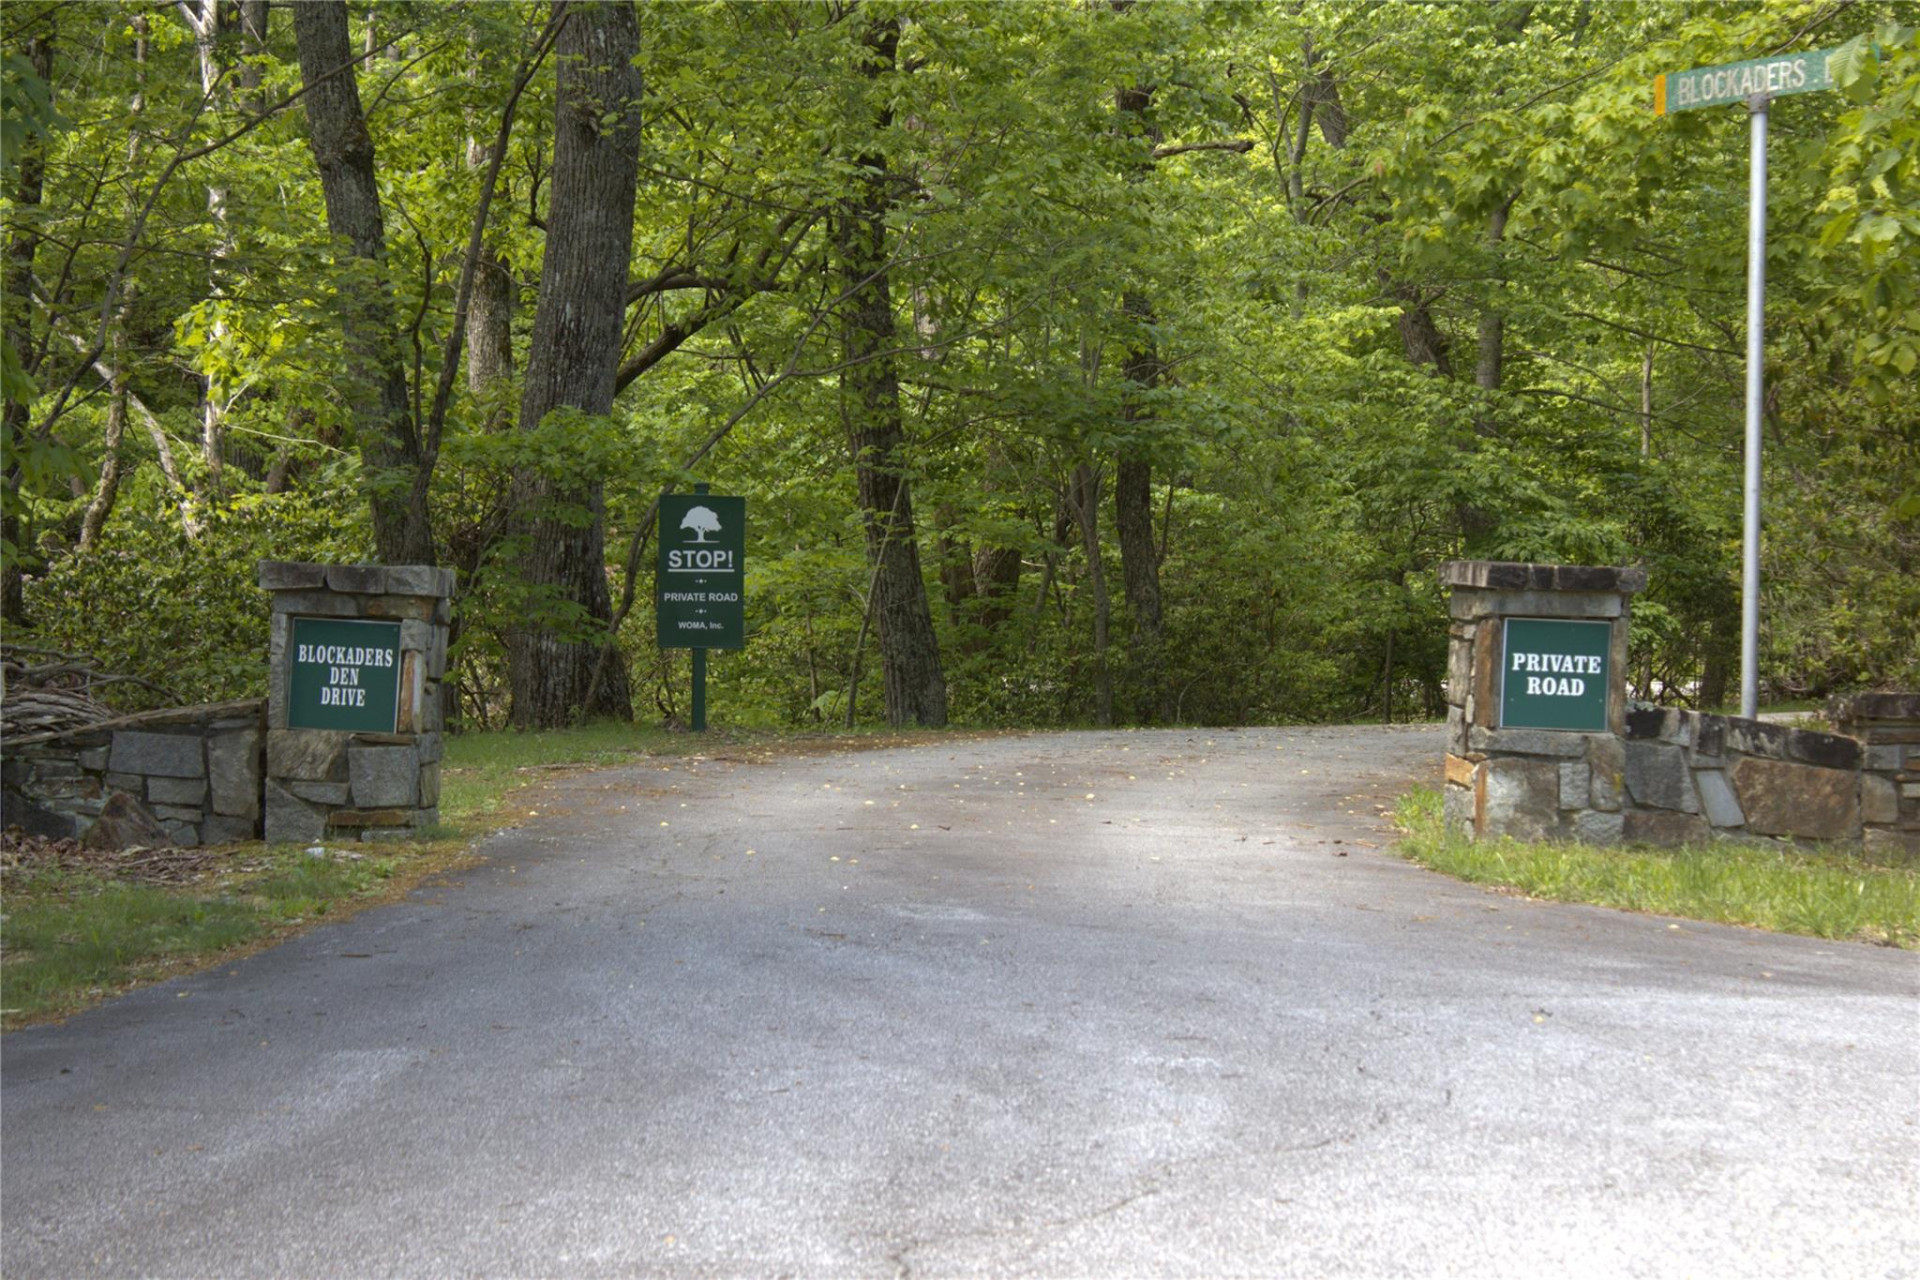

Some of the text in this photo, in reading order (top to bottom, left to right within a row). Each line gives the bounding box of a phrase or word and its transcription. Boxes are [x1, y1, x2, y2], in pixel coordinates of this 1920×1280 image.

[1677, 58, 1806, 106] BLOCKADERS
[668, 550, 733, 568] STOP!
[664, 592, 738, 602] PRIVATE ROAD
[678, 621, 724, 630] WOMA, Inc.
[298, 644, 394, 668] BLOCKADERS
[1511, 652, 1602, 674] PRIVATE
[329, 666, 360, 686] DEN
[1526, 676, 1585, 696] ROAD
[320, 686, 366, 707] DRIVE
